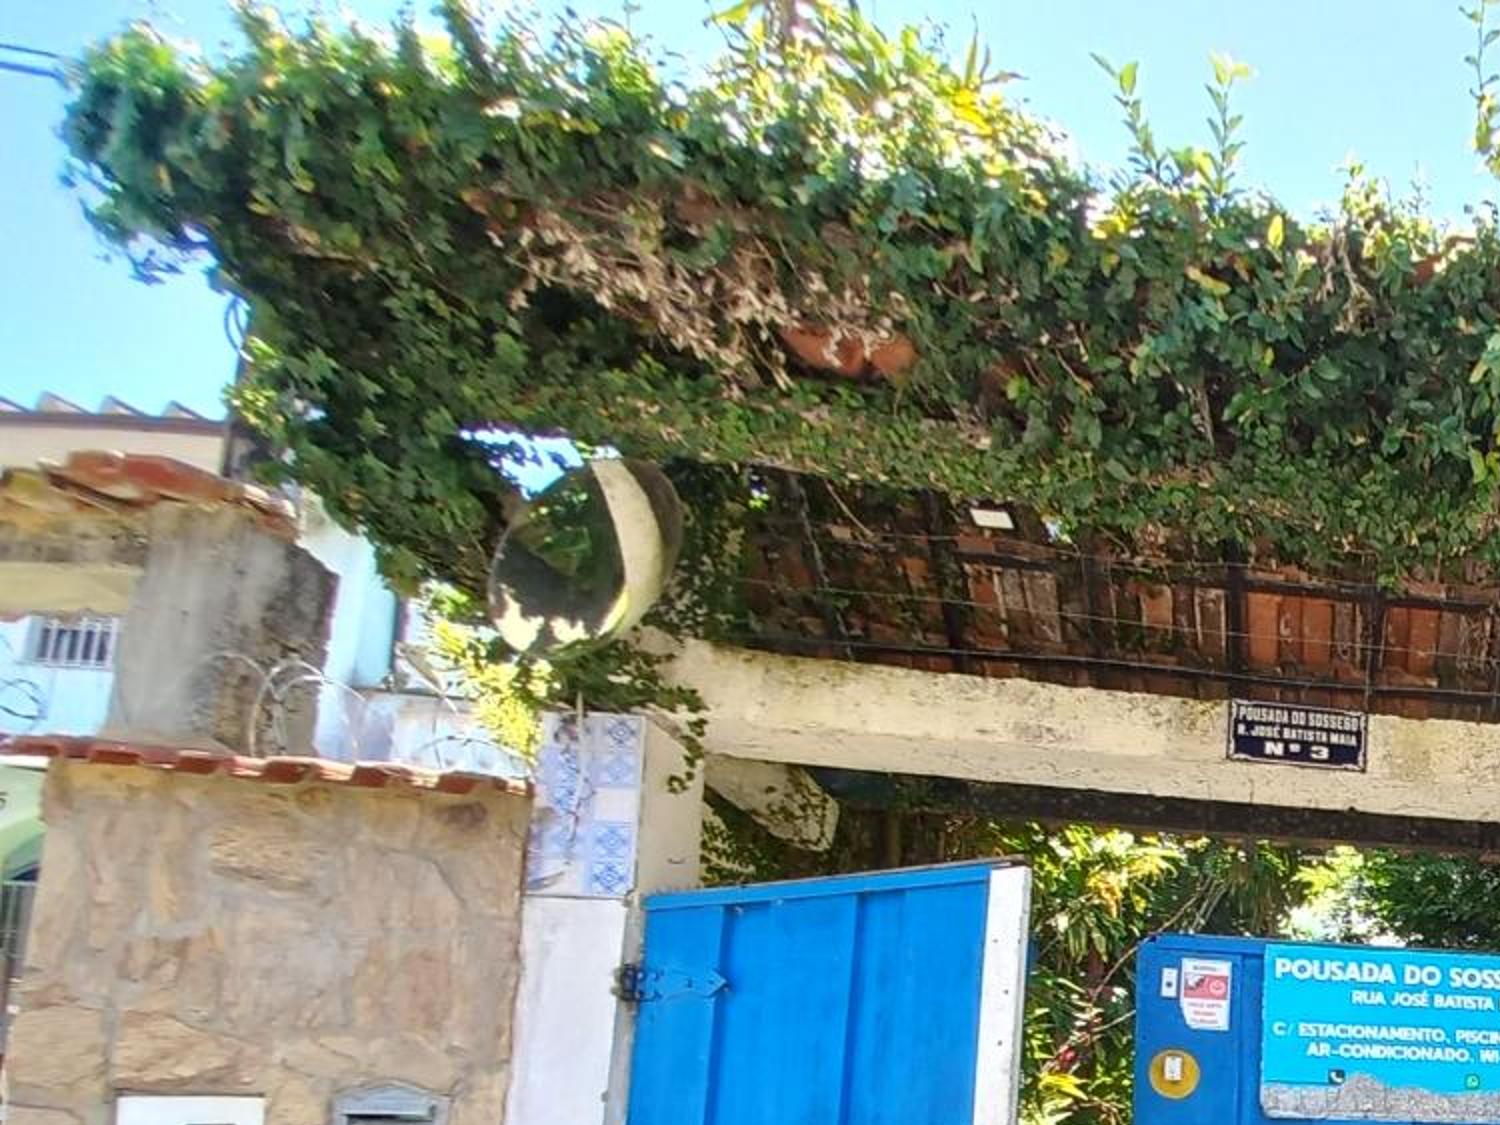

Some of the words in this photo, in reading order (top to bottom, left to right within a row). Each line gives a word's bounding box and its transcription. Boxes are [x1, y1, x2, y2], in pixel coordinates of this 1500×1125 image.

[1239, 706, 1289, 723] POUSADA
[1291, 711, 1306, 726] DO
[1308, 713, 1359, 731] SOSSEGO
[1237, 723, 1249, 735] R.
[1251, 724, 1280, 739] JOSÉ
[1283, 728, 1327, 742] BATISTA
[1330, 733, 1357, 746] MAIA
[1310, 745, 1330, 760] 3
[1275, 957, 1397, 984] POUSADA
[1404, 964, 1442, 987] DO
[1351, 990, 1386, 1006] RUA
[1391, 989, 1430, 1008] JOSÉ
[1434, 994, 1495, 1011] BATISTA
